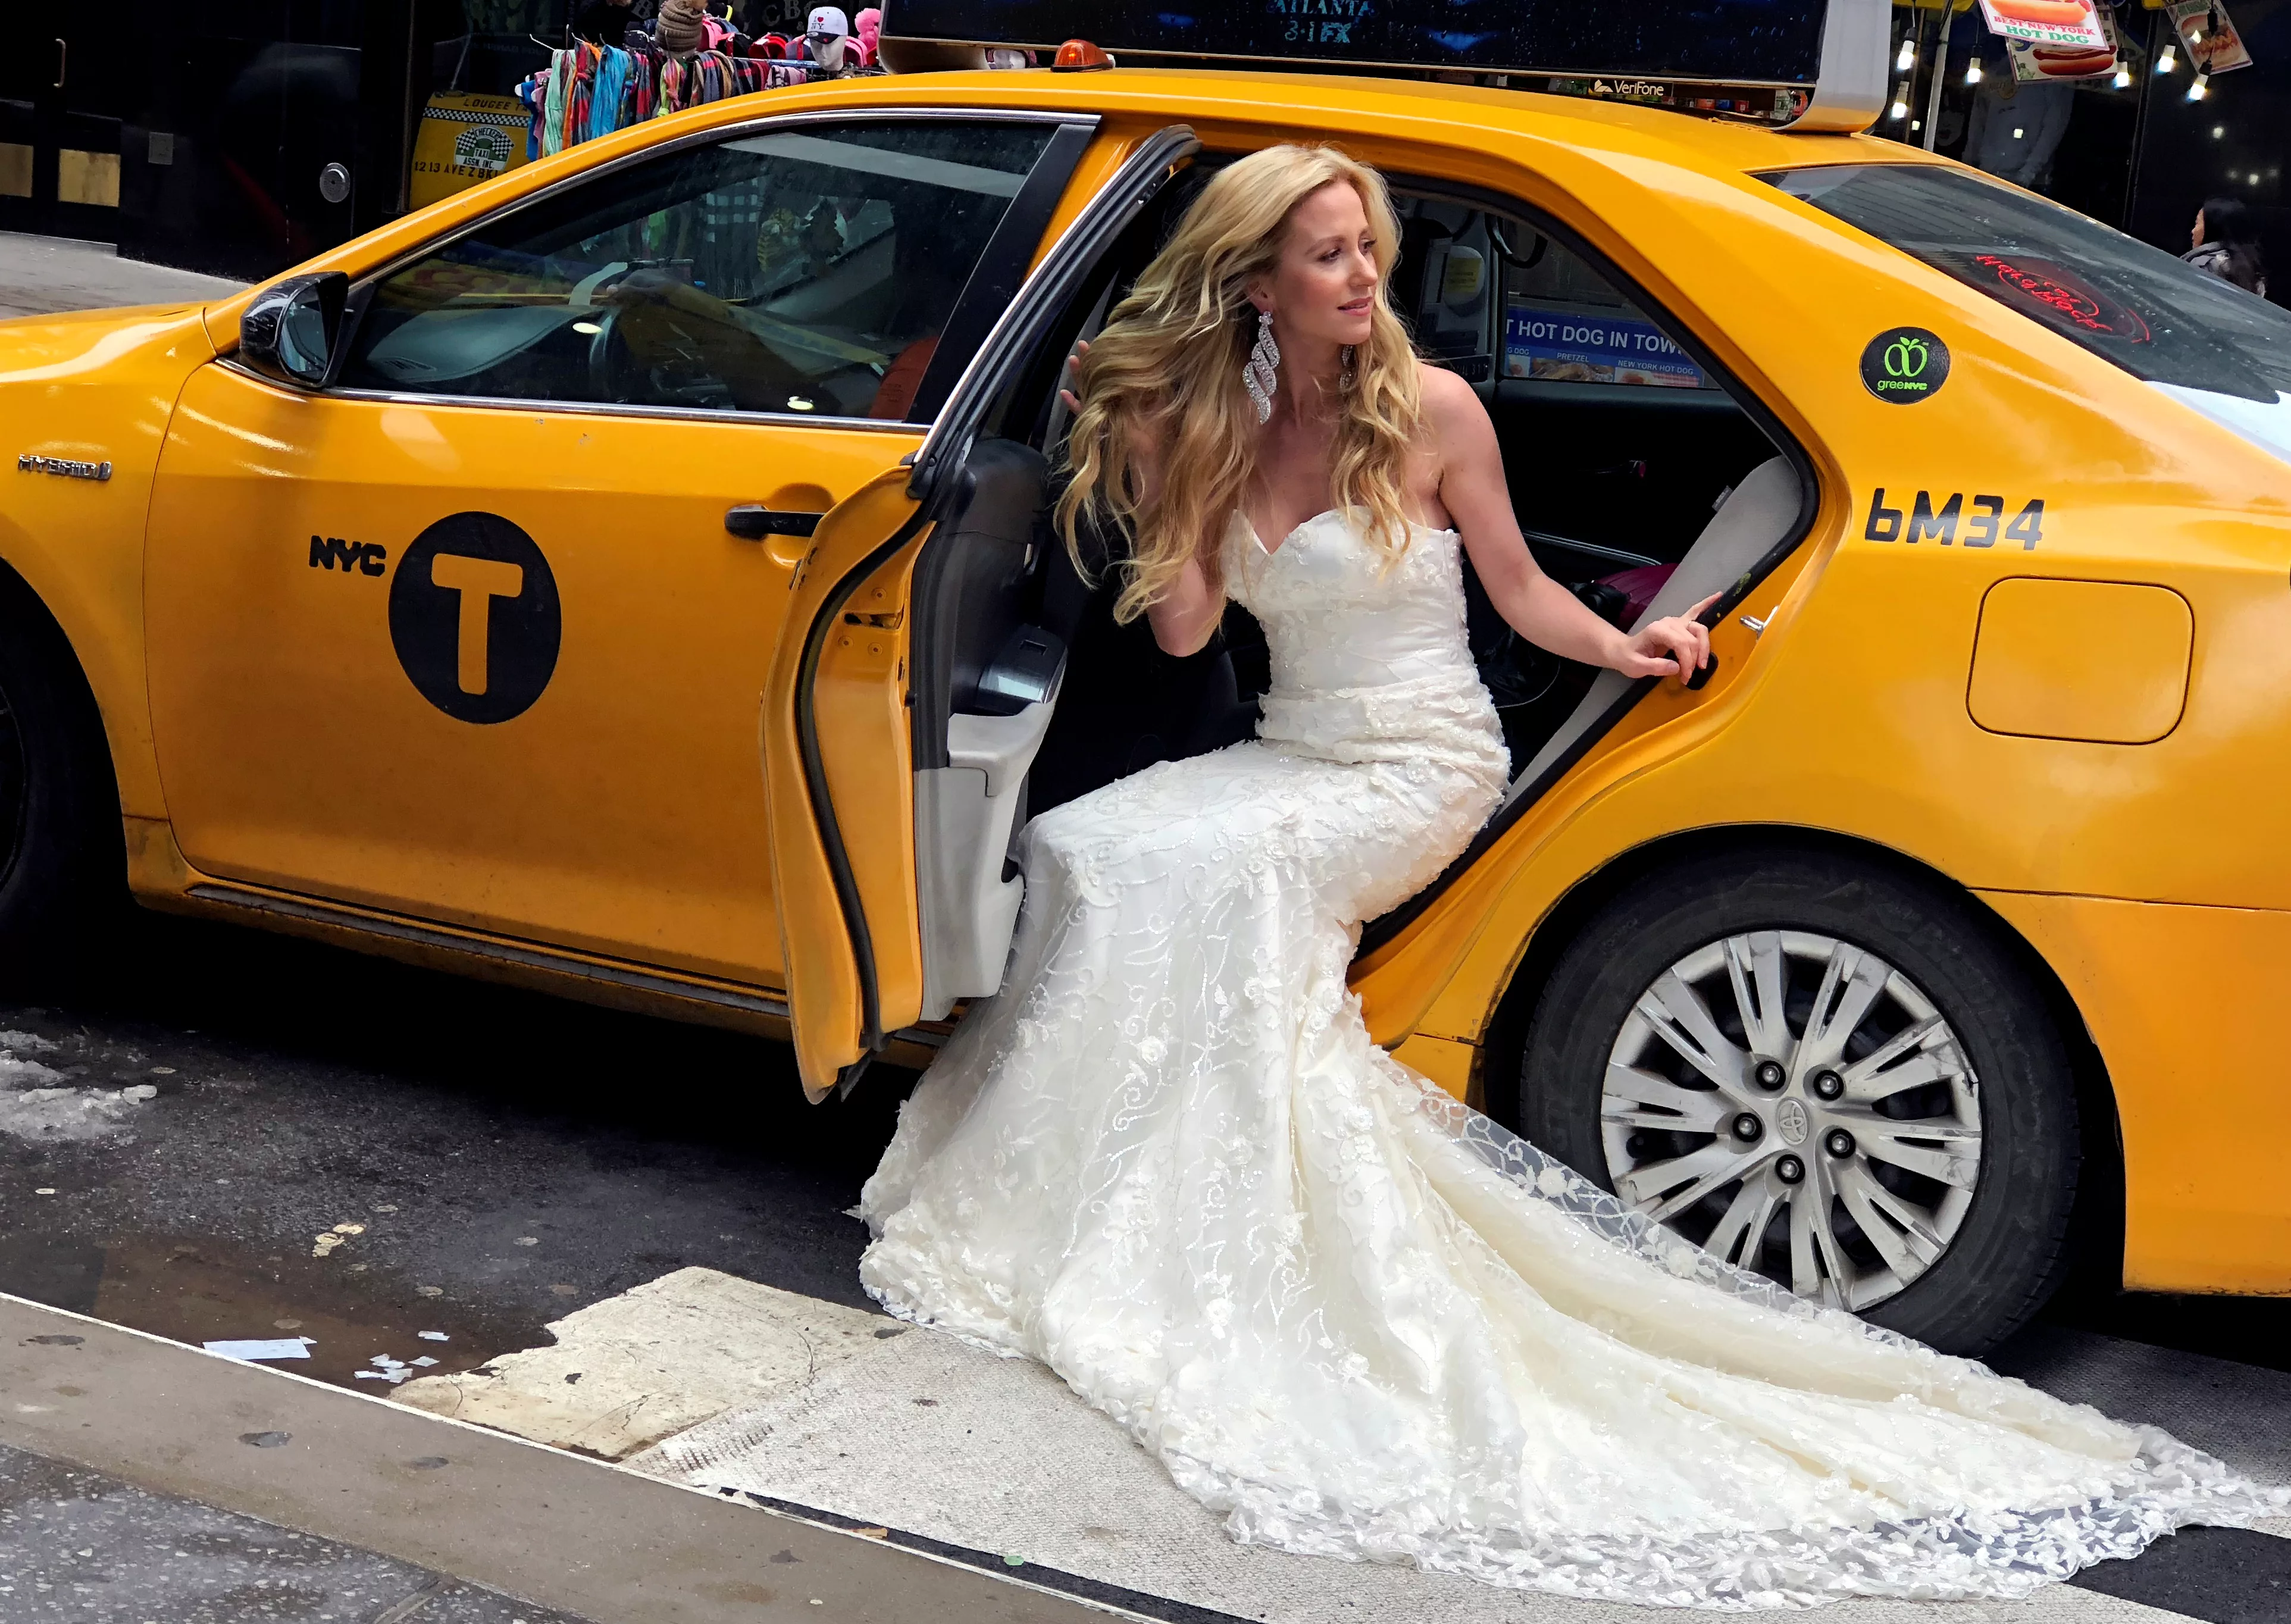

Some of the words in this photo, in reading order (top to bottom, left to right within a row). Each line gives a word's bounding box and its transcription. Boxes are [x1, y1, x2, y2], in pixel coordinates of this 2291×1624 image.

[1993, 15, 2026, 27] BEST
[2026, 21, 2056, 31] NEW
[2057, 26, 2095, 36] YORK
[2005, 25, 2043, 39] HOT
[2048, 32, 2089, 44] DOG
[1614, 80, 1664, 96] VeriFone
[463, 98, 511, 110] LOUGEE
[475, 149, 489, 158] TAXI
[444, 164, 464, 176] AVE
[468, 167, 475, 177] Z
[1518, 320, 1558, 339] HOT
[1562, 326, 1604, 346] DOG
[1610, 331, 1628, 348] IN
[1557, 352, 1589, 362] PRETZEL
[1618, 359, 1635, 369] NEW
[1636, 362, 1658, 371] YORK
[1659, 364, 1676, 373] HOT
[1677, 366, 1694, 376] DOG
[309, 535, 387, 577] NYC
[431, 553, 524, 696] T
